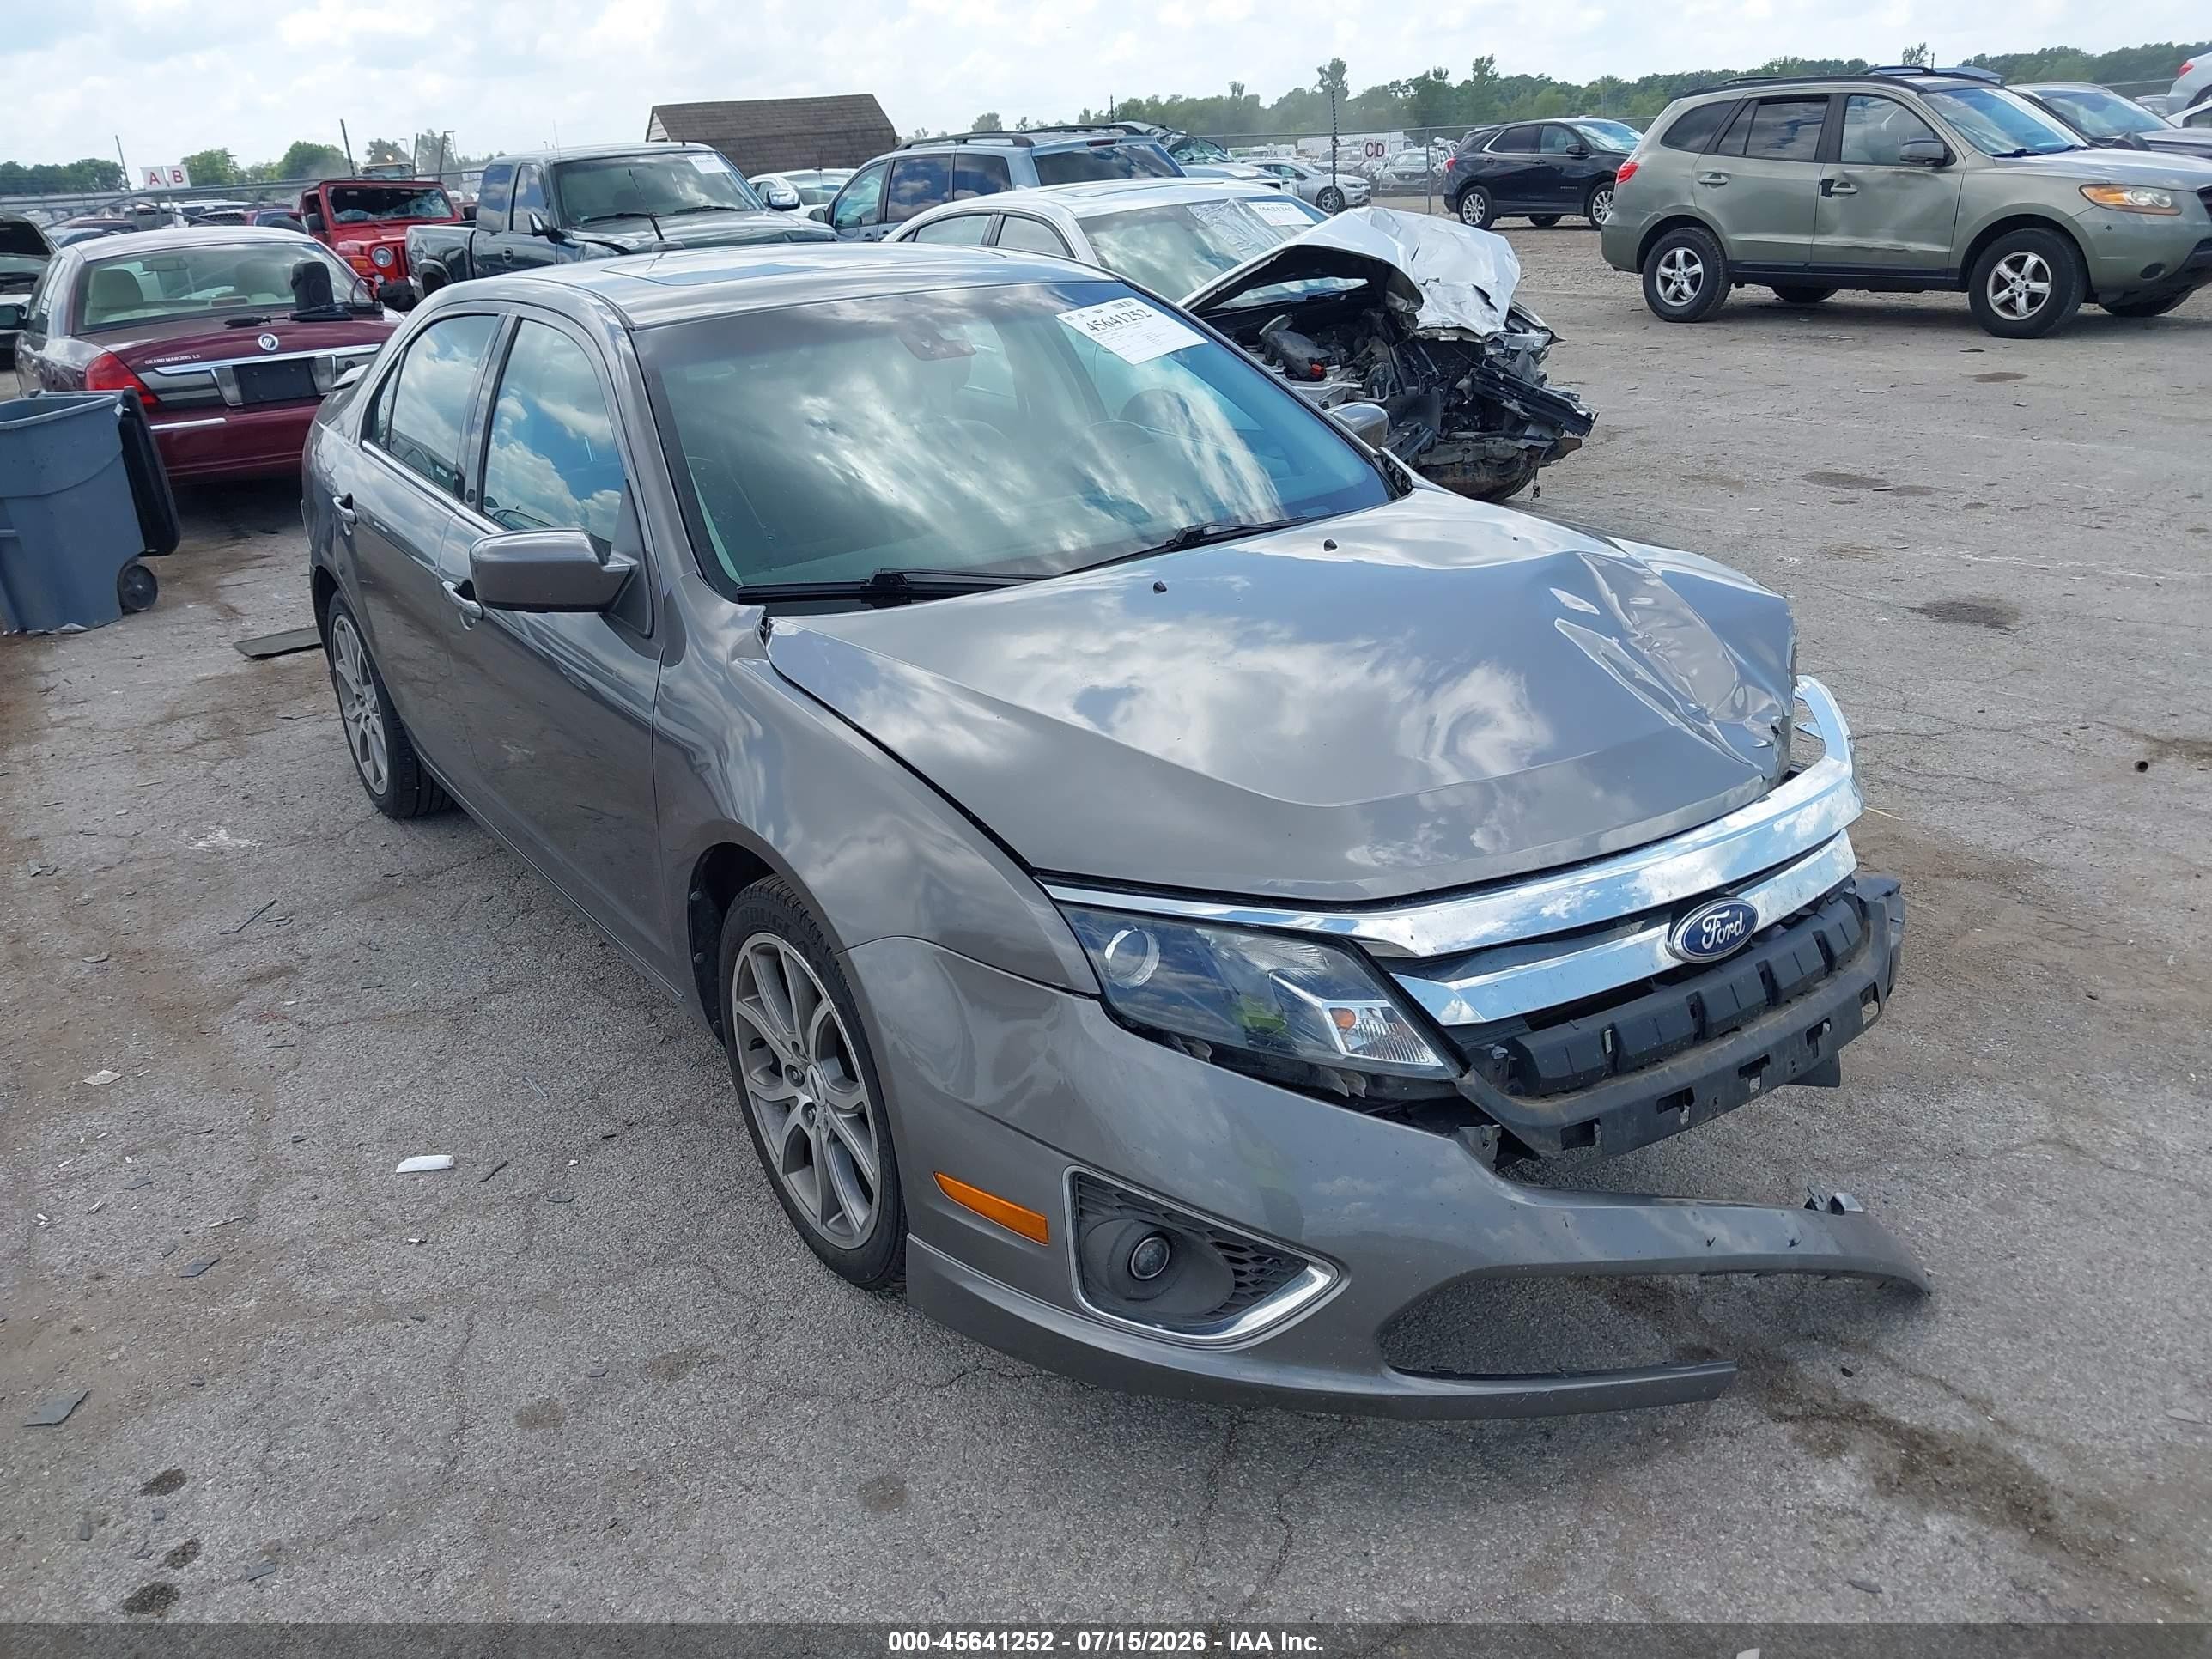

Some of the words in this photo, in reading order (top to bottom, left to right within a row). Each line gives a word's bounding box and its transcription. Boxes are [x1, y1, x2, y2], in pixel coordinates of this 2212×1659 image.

[149, 171, 161, 185] A
[172, 170, 185, 183] B
[1085, 308, 1152, 331] 45641252
[1701, 908, 1746, 950] Ford
